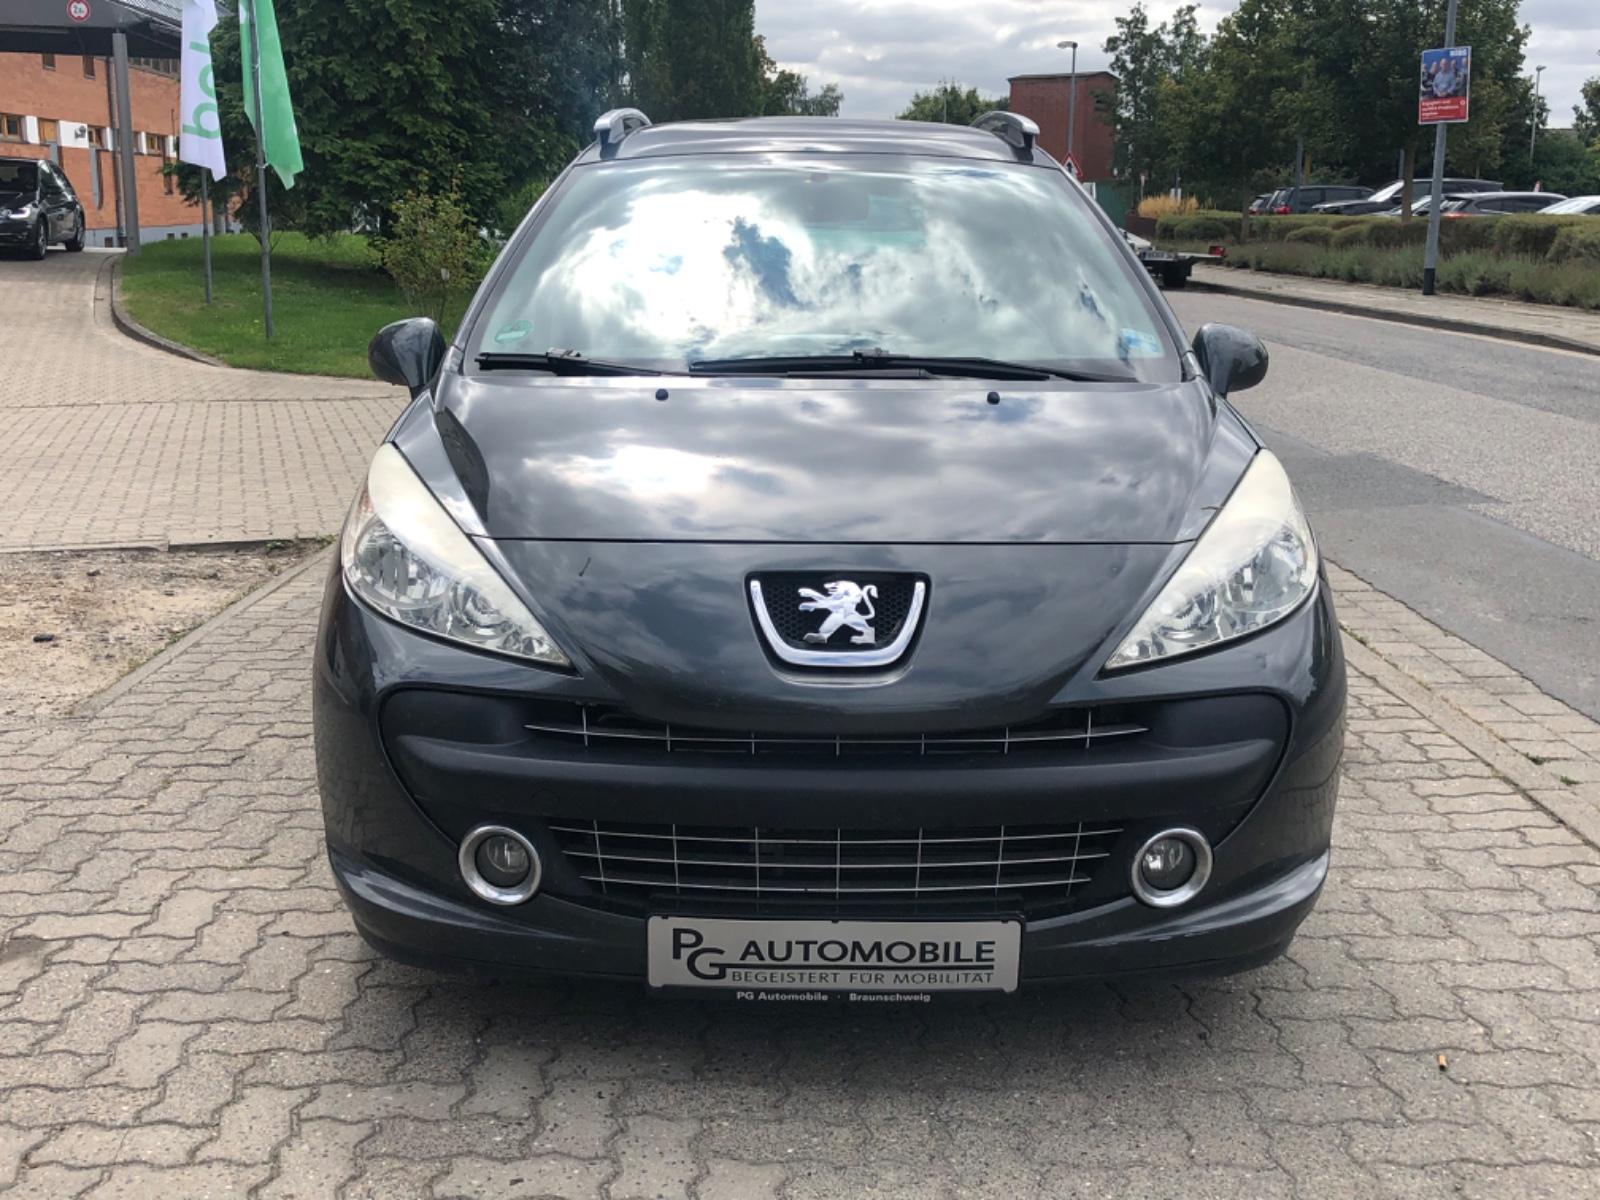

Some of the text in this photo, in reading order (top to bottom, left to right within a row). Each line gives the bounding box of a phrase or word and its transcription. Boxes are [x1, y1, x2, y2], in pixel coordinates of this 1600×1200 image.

[672, 928, 996, 980] PG AUTOMOBILE
[732, 971, 993, 985] BEGEISTERT FÜR MOBILITÄT
[736, 991, 931, 1003] PG Automobile Braunschweig
